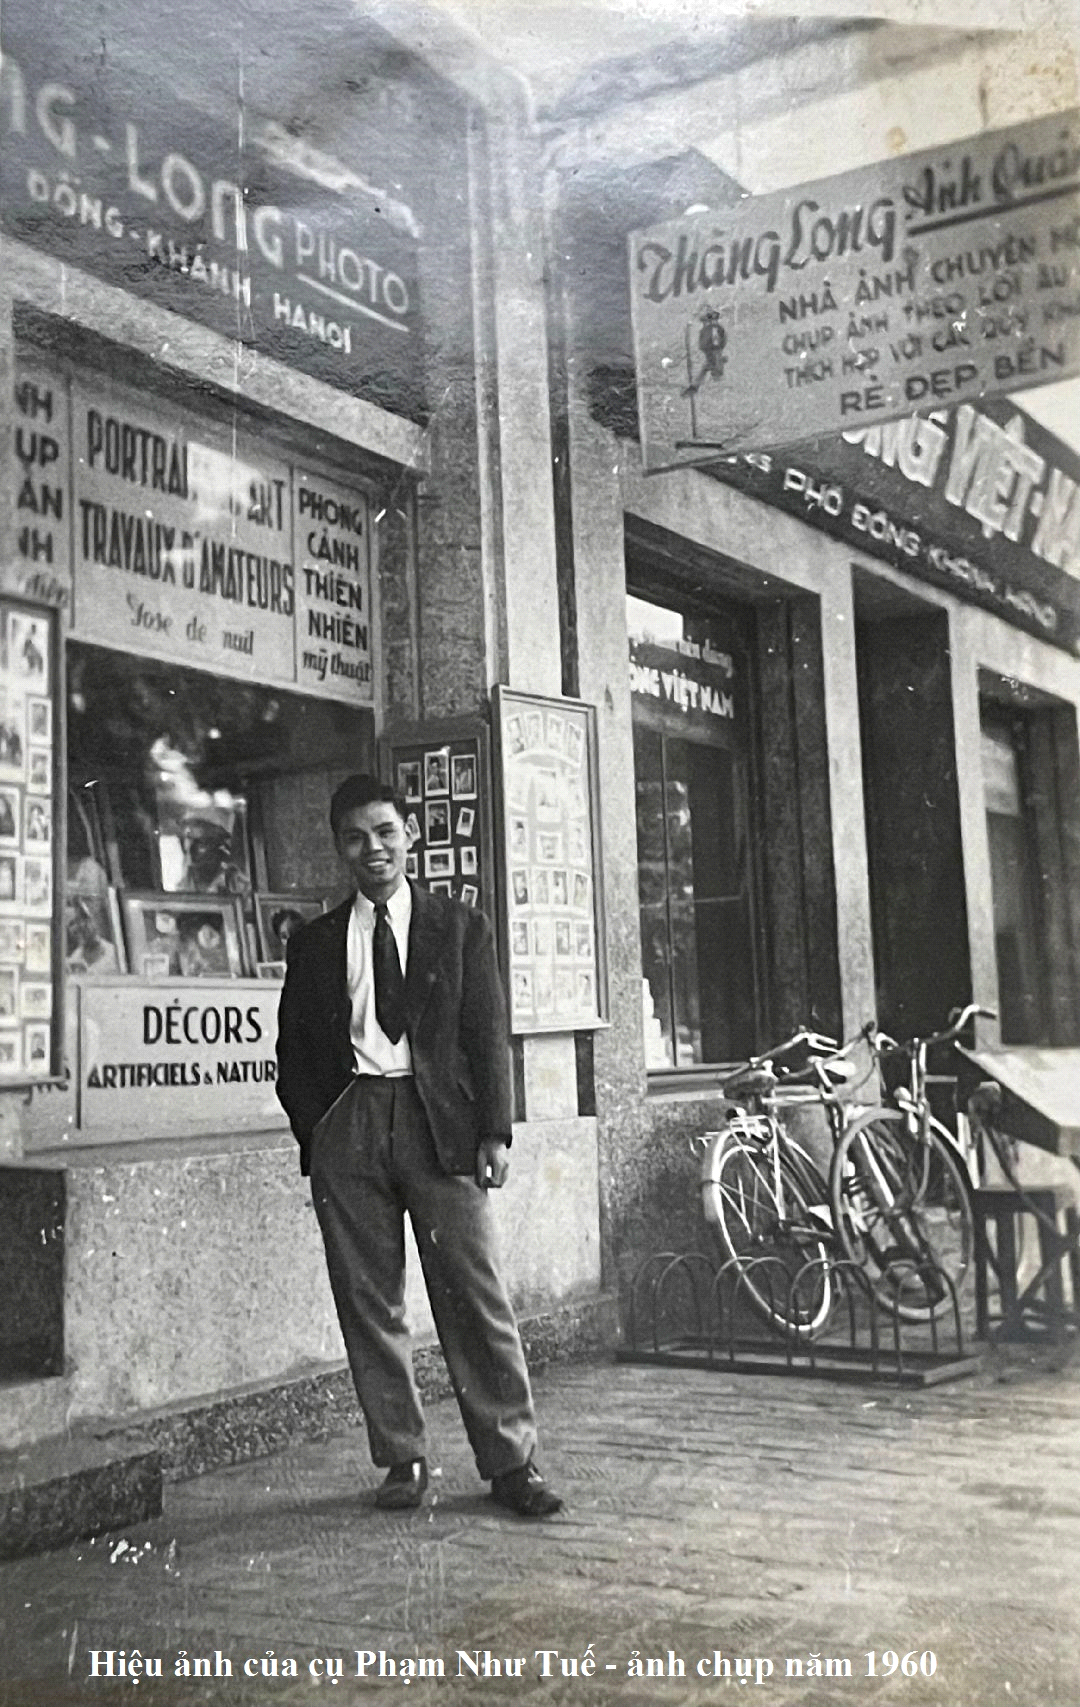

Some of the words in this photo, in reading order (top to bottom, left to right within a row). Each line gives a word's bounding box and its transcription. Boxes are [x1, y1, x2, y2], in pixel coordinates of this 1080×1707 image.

[785, 198, 897, 270] Long
[295, 221, 410, 314] PHOTO
[273, 292, 352, 354] HANOI
[299, 486, 362, 536] PHONG
[79, 500, 176, 585] TRAVAUX
[302, 566, 362, 611] THIÊN
[186, 615, 208, 642] de
[308, 609, 368, 651] NHIÊN
[700, 685, 734, 719] NAM
[142, 997, 263, 1045] DÉCORS
[87, 1061, 202, 1089] ARTIFICIELS
